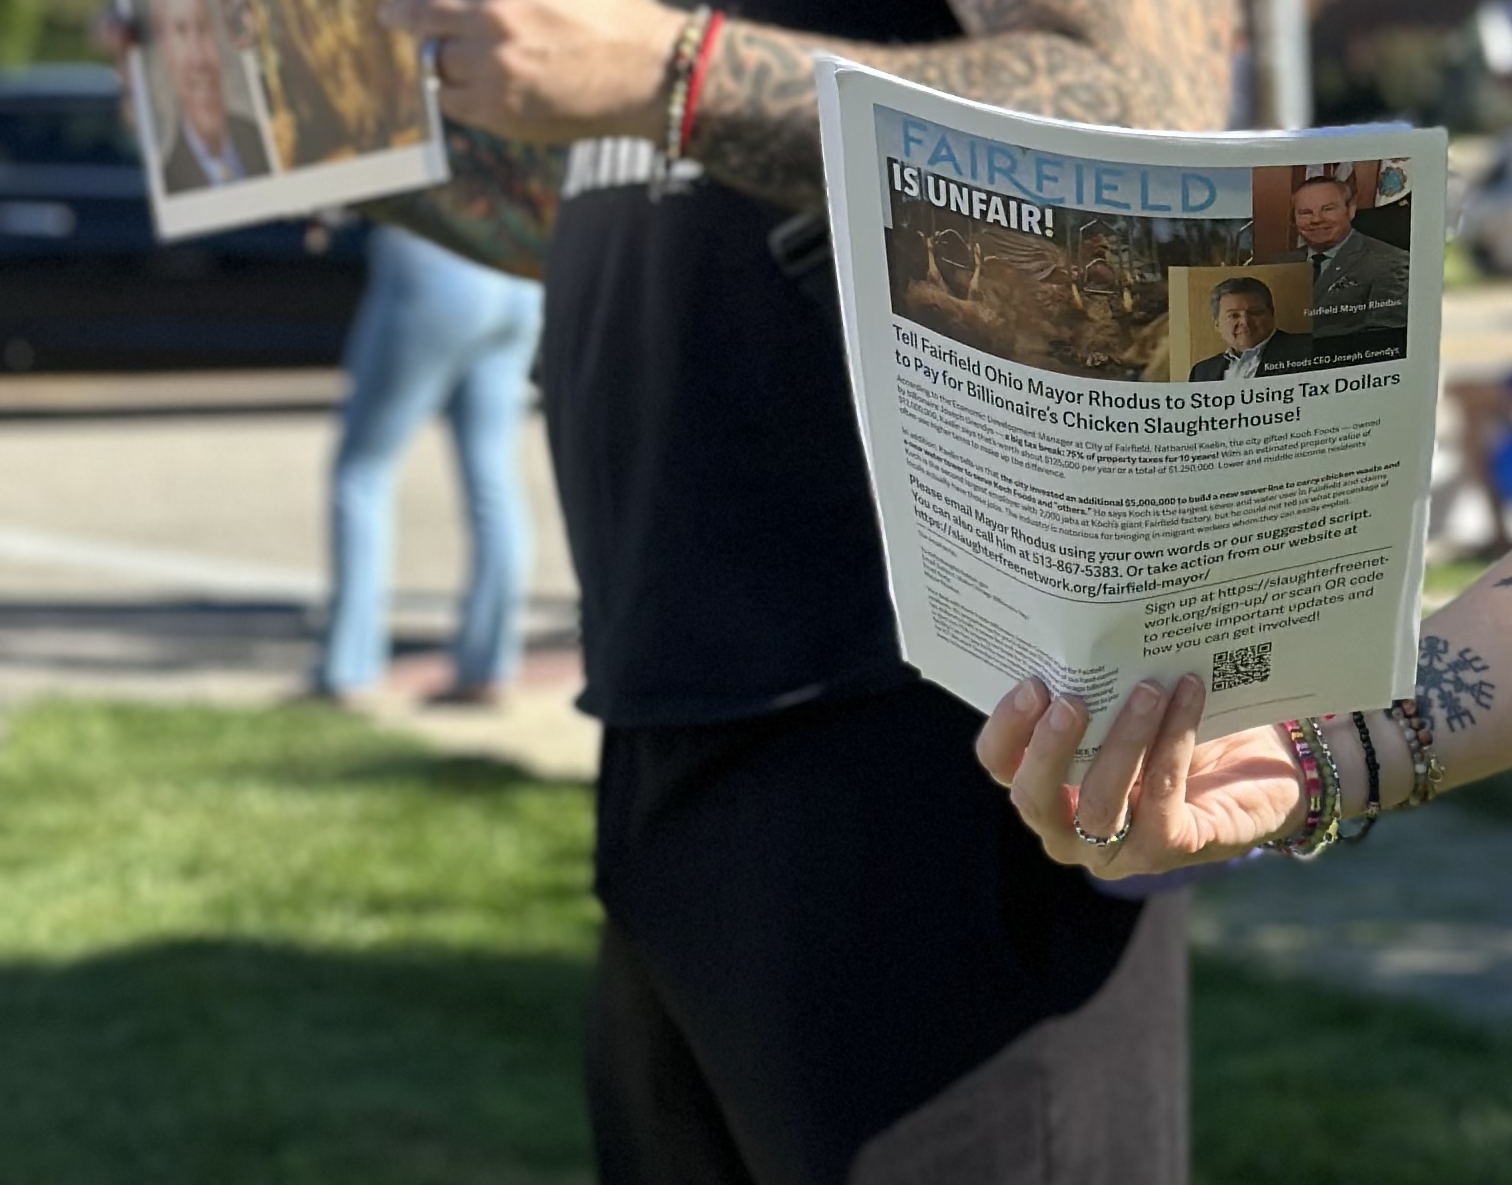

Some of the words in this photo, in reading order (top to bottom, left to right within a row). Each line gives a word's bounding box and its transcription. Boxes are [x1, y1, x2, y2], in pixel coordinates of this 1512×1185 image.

[901, 118, 1217, 213] FAIRFIELD
[892, 161, 920, 198] IS
[927, 176, 1054, 238] UNFAIR!
[1340, 304, 1366, 313] Mayor
[1368, 299, 1401, 308] Rhodus
[892, 324, 917, 349] Tell
[921, 338, 980, 376] Fairfield
[984, 366, 1022, 390] Ohio
[1027, 378, 1082, 404] Mayor
[1088, 391, 1160, 409] Rhodus
[1165, 396, 1184, 409] to
[1189, 393, 1234, 410] Stop
[1240, 388, 1294, 404] Using
[1298, 383, 1329, 397] Tax
[1334, 374, 1400, 393] Dollars
[1264, 361, 1284, 370] Koch
[1286, 359, 1311, 367] Foods
[1332, 352, 1362, 362] Joseph
[895, 350, 910, 367] to
[914, 357, 939, 384] Pay
[941, 369, 963, 391] for
[966, 381, 1057, 424] Billionaire's
[1062, 412, 1138, 433] Chicken
[1143, 407, 1300, 436] Slaughterhouse!
[1066, 450, 1083, 459] 75%
[1096, 455, 1136, 465] property
[1138, 455, 1163, 463] taxes
[1177, 453, 1188, 461] 10
[1085, 442, 1102, 454] City
[909, 474, 942, 501] Please
[944, 496, 972, 516] email
[974, 508, 1008, 534] Mayor
[1011, 526, 1055, 552] Rhodus
[1059, 546, 1094, 563] using
[1099, 552, 1130, 563] your
[1134, 550, 1163, 560] own
[1166, 541, 1209, 556] words
[1213, 539, 1229, 548] or
[1230, 535, 1253, 545] our
[1256, 517, 1325, 540] suggested
[1329, 508, 1371, 524] script.
[1078, 496, 1122, 506] additional
[911, 487, 930, 509] You
[932, 505, 950, 520] can
[952, 516, 973, 534] also
[975, 529, 993, 544] call
[995, 536, 1015, 554] him
[1018, 550, 1030, 561] at
[1032, 552, 1122, 577] 513-867-5383.
[1126, 566, 1143, 577] Or
[1147, 562, 1177, 575] take
[1180, 555, 1223, 569] action
[1227, 548, 1259, 560] from
[1262, 543, 1283, 552] our
[1287, 530, 1341, 547] website
[1343, 525, 1357, 535] at
[1144, 602, 1174, 614] Sign
[1179, 597, 1196, 607] up
[1200, 591, 1214, 602] at
[1271, 592, 1287, 601] or
[1288, 585, 1320, 597] scan
[1324, 577, 1345, 591] QR
[1349, 571, 1383, 585] code
[1143, 645, 1172, 657] how
[1175, 638, 1200, 653] you
[1204, 632, 1229, 643] can
[1232, 625, 1255, 640] get
[1258, 611, 1319, 632] involved!
[1144, 633, 1157, 643] to
[1162, 622, 1211, 638] receive
[1215, 605, 1284, 627] important
[1288, 595, 1344, 612] updates
[1347, 586, 1373, 600] and
